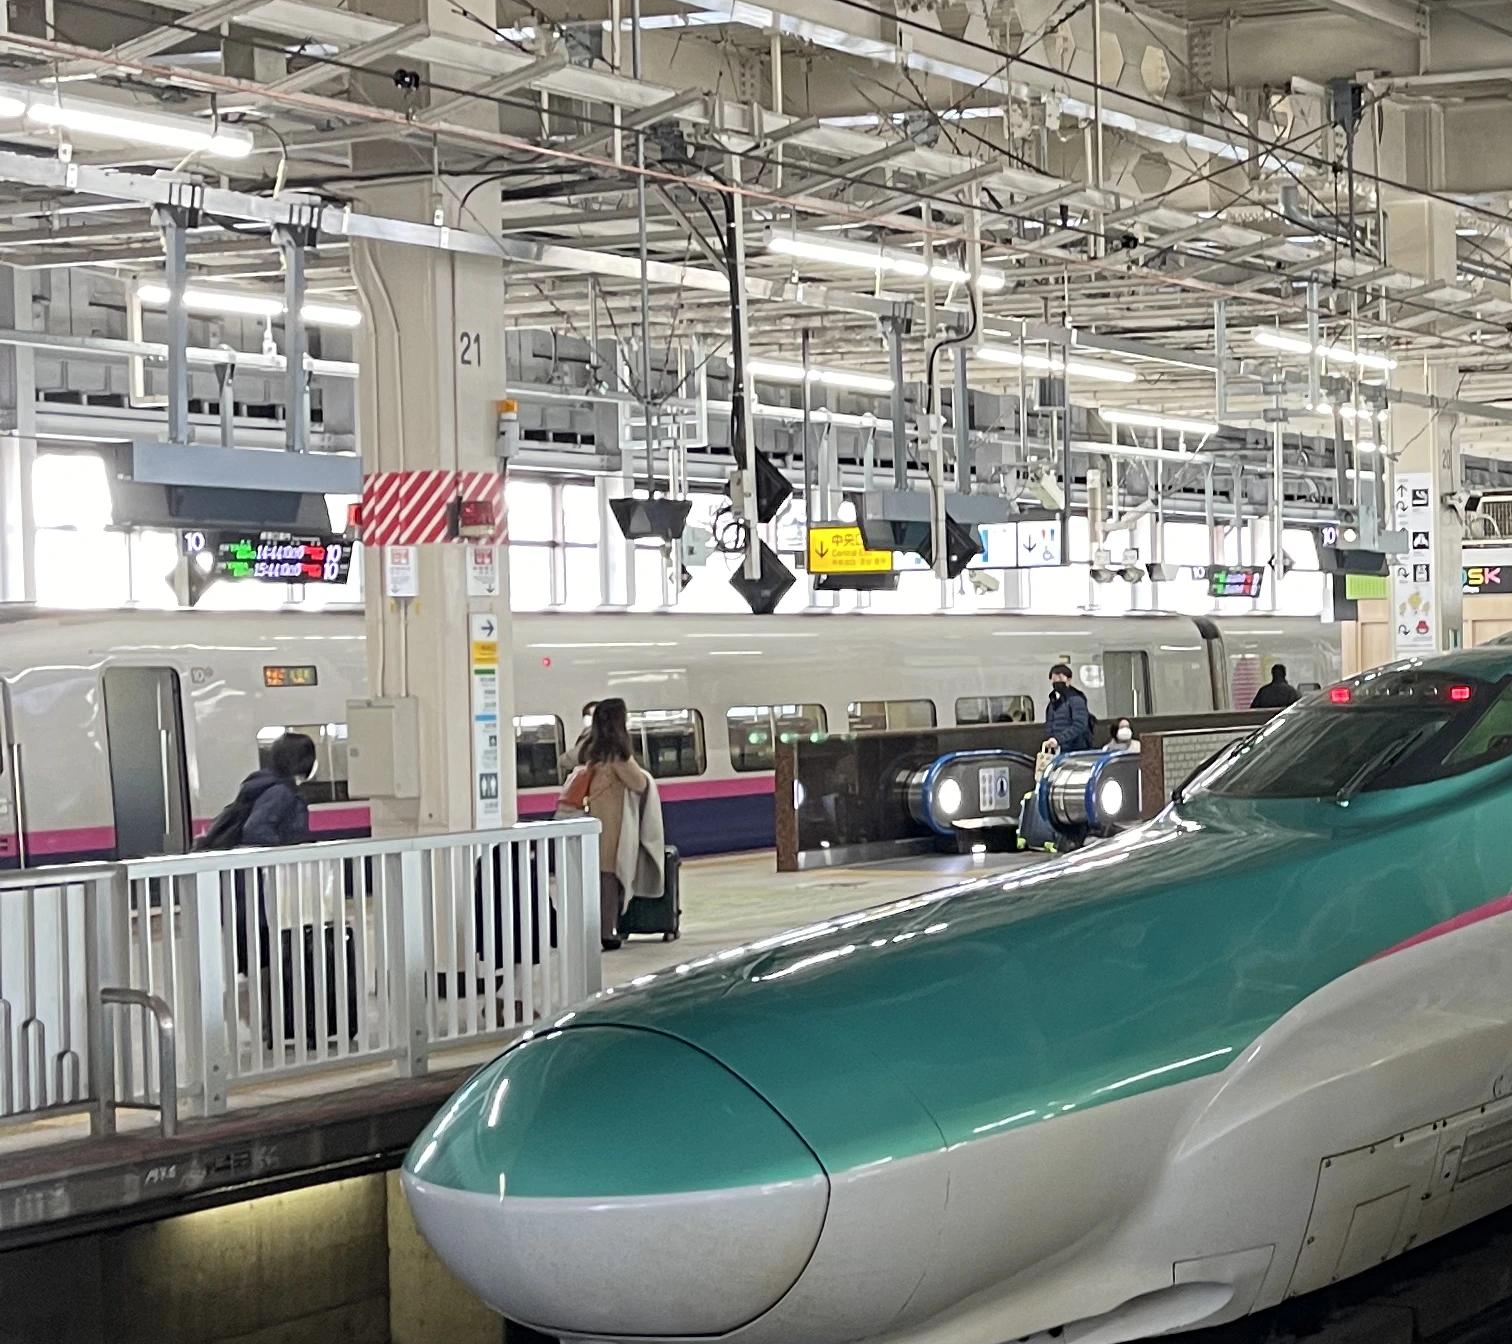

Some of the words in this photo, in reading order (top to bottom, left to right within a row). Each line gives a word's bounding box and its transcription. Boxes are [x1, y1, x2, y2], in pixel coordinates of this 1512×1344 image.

[459, 331, 482, 368] 21
[1442, 448, 1452, 470] 20
[183, 531, 206, 552] 10
